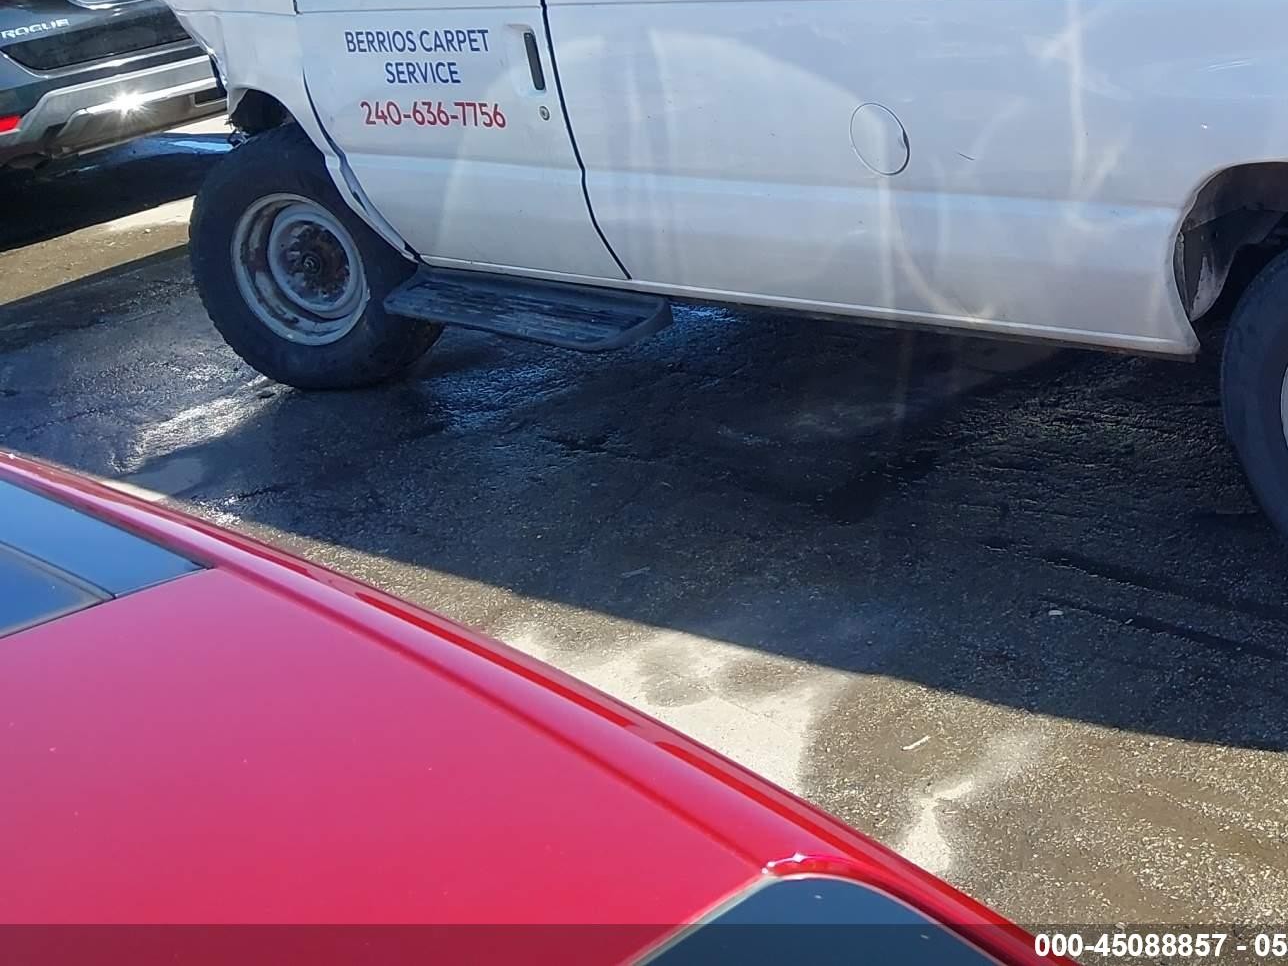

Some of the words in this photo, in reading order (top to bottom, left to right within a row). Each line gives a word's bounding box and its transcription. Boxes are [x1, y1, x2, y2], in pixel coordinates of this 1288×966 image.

[1, 18, 71, 39] ROGUE
[344, 30, 417, 53] BERRIOS
[420, 29, 489, 52] CARPET
[385, 62, 462, 84] SERVICE
[360, 100, 507, 129] 240-636-7756
